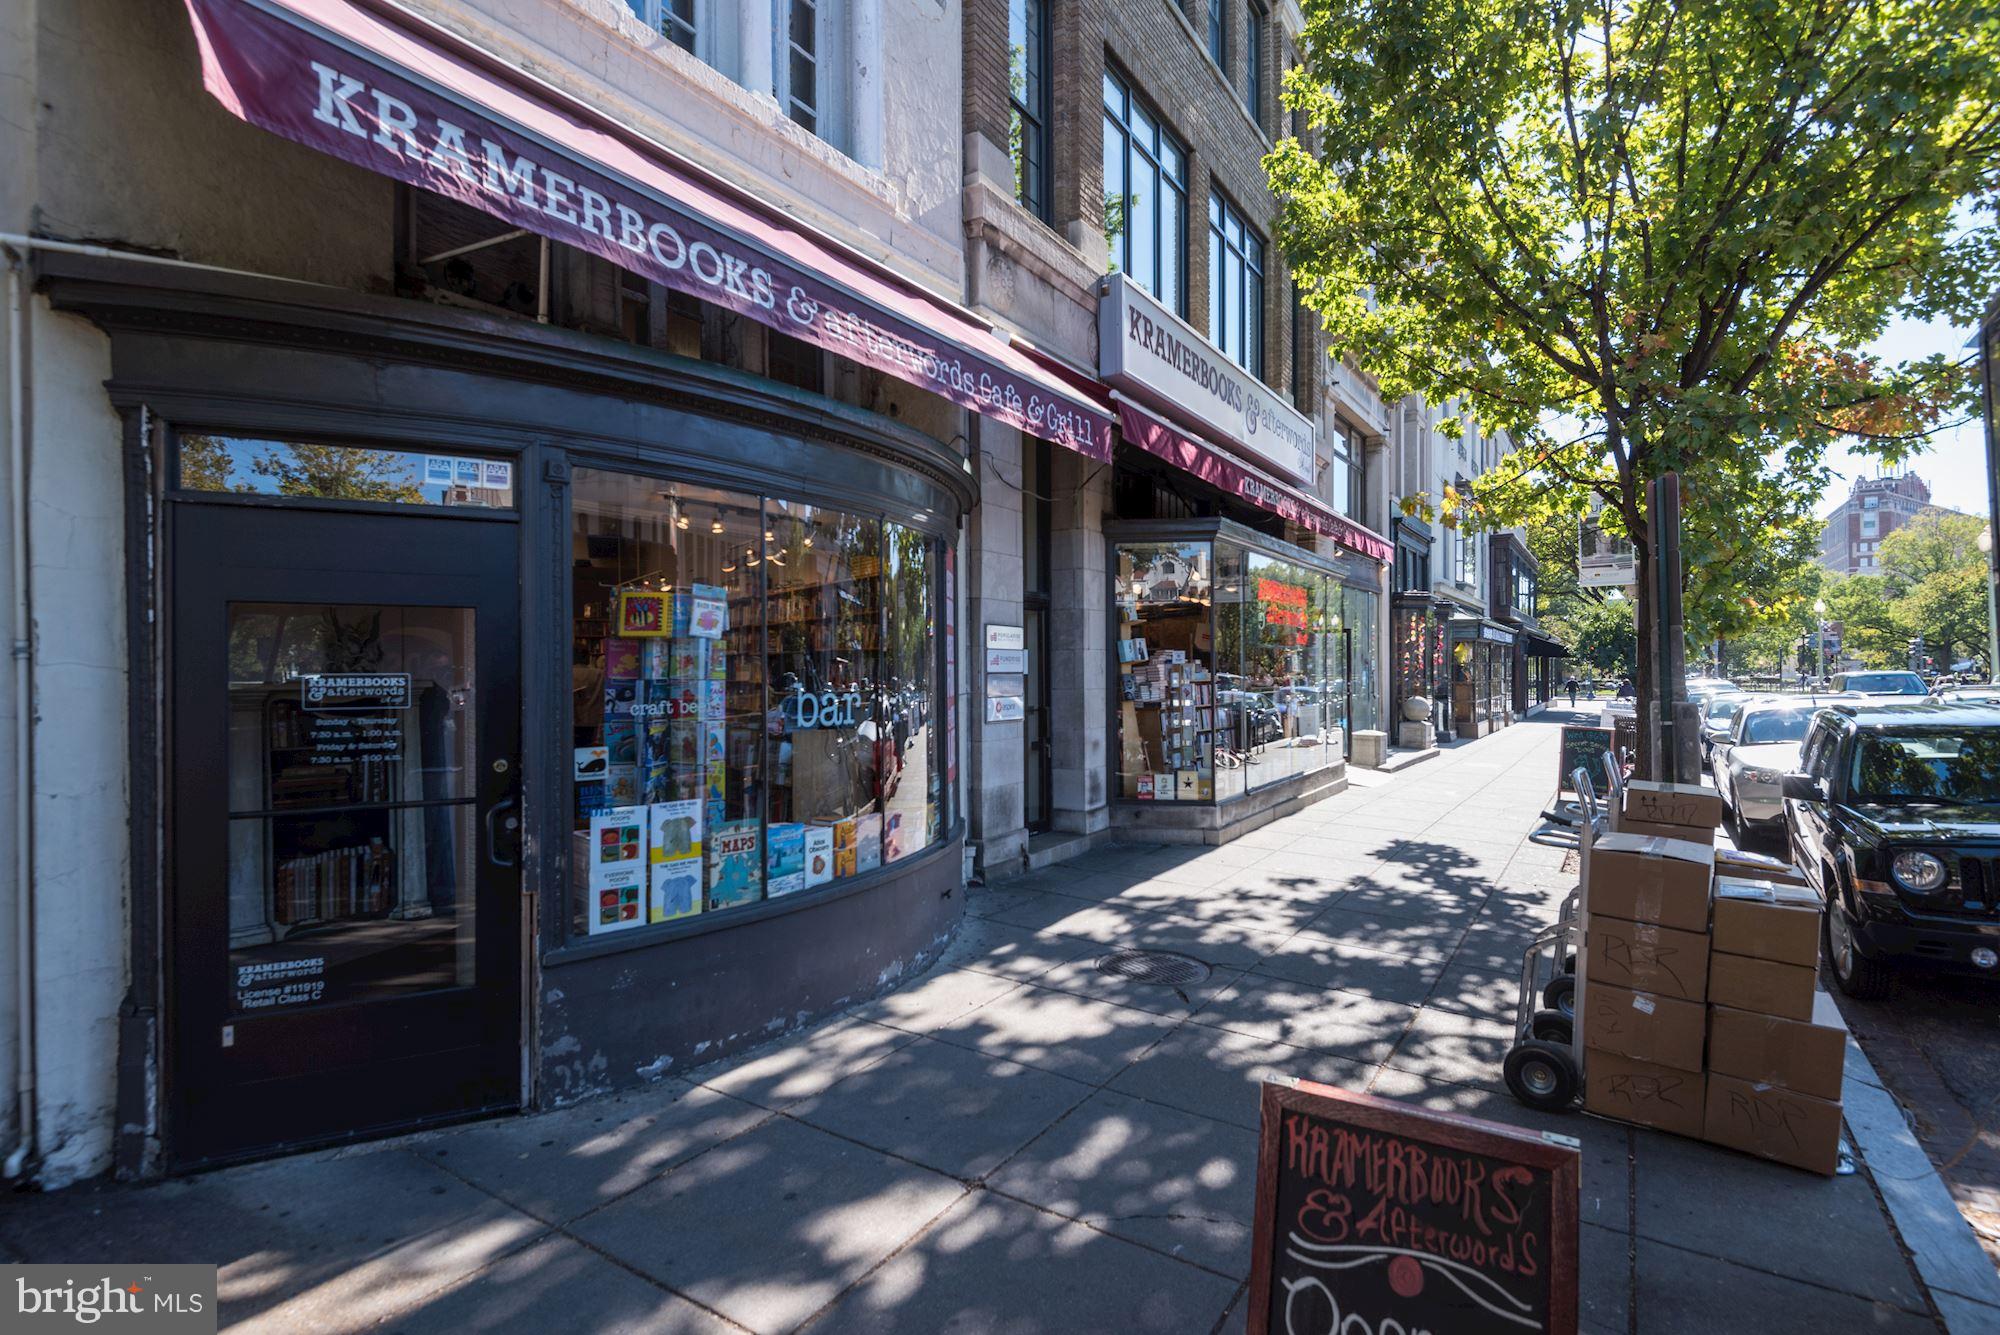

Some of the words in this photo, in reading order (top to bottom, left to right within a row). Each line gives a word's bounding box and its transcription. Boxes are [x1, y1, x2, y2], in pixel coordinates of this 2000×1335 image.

[310, 59, 776, 310] KRAMERBOOKS
[786, 285, 818, 327] &
[824, 311, 975, 397] afterwords
[1027, 393, 1046, 425] &
[1046, 404, 1094, 447] Grill
[1129, 304, 1243, 414] KRAMERBOOKS
[1245, 393, 1261, 436] &
[1261, 407, 1312, 458] afterwords
[308, 677, 406, 686] KRAMERBOOKS
[308, 687, 327, 700] &
[327, 687, 405, 696] afterwords
[630, 700, 674, 716] craft
[796, 682, 862, 728] bar
[357, 717, 399, 725] Thursday
[316, 743, 346, 752] Friday
[721, 835, 755, 854] MAPS
[237, 957, 325, 974] KRAMERBOOKS
[253, 966, 324, 981] afterwords
[236, 987, 282, 1000] License
[242, 997, 276, 1008] Retail
[278, 993, 310, 1004] Class
[311, 990, 322, 1000] C
[1285, 1114, 1534, 1236] KRAMERBOOKS
[1297, 1188, 1352, 1243] &
[1355, 1196, 1538, 1277] Afterwords
